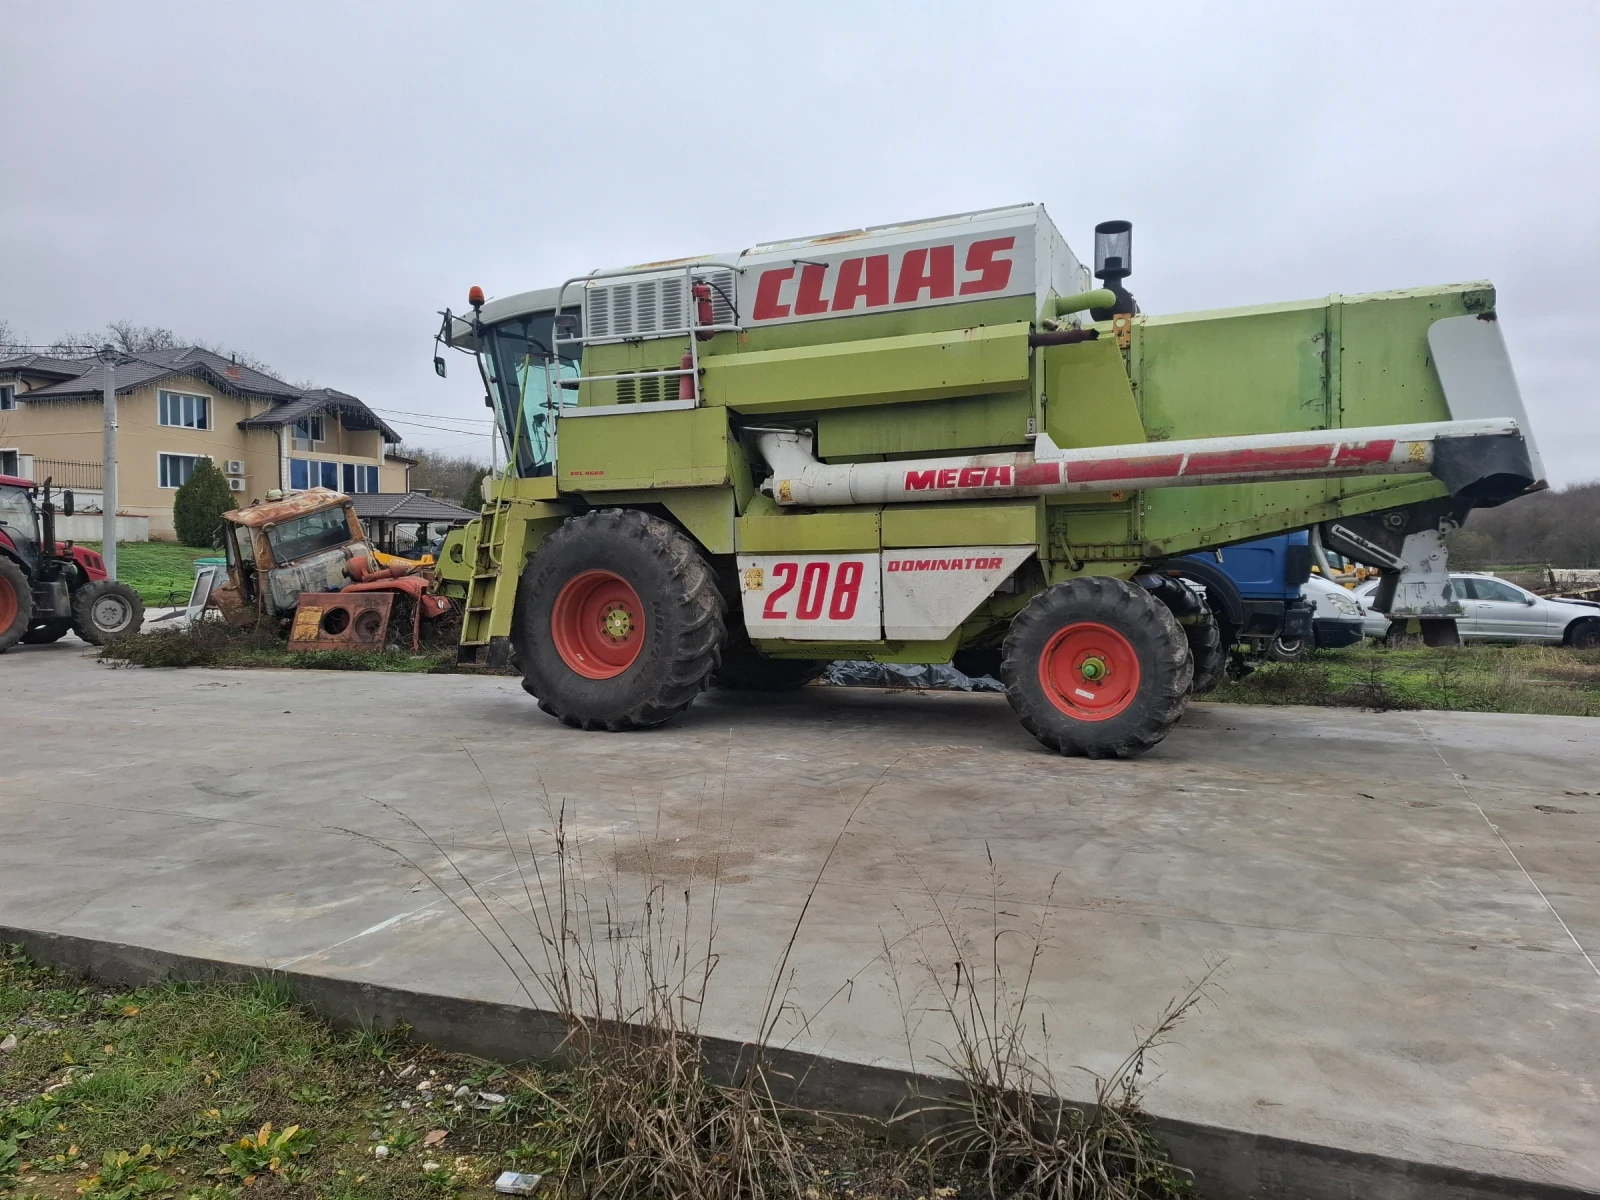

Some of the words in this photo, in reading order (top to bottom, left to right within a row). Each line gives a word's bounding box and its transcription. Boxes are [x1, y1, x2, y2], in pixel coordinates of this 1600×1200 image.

[752, 236, 1016, 321] CLAAS
[904, 465, 1012, 490] MEGA
[887, 557, 1004, 572] DOMINATOR
[762, 561, 864, 621] 208
